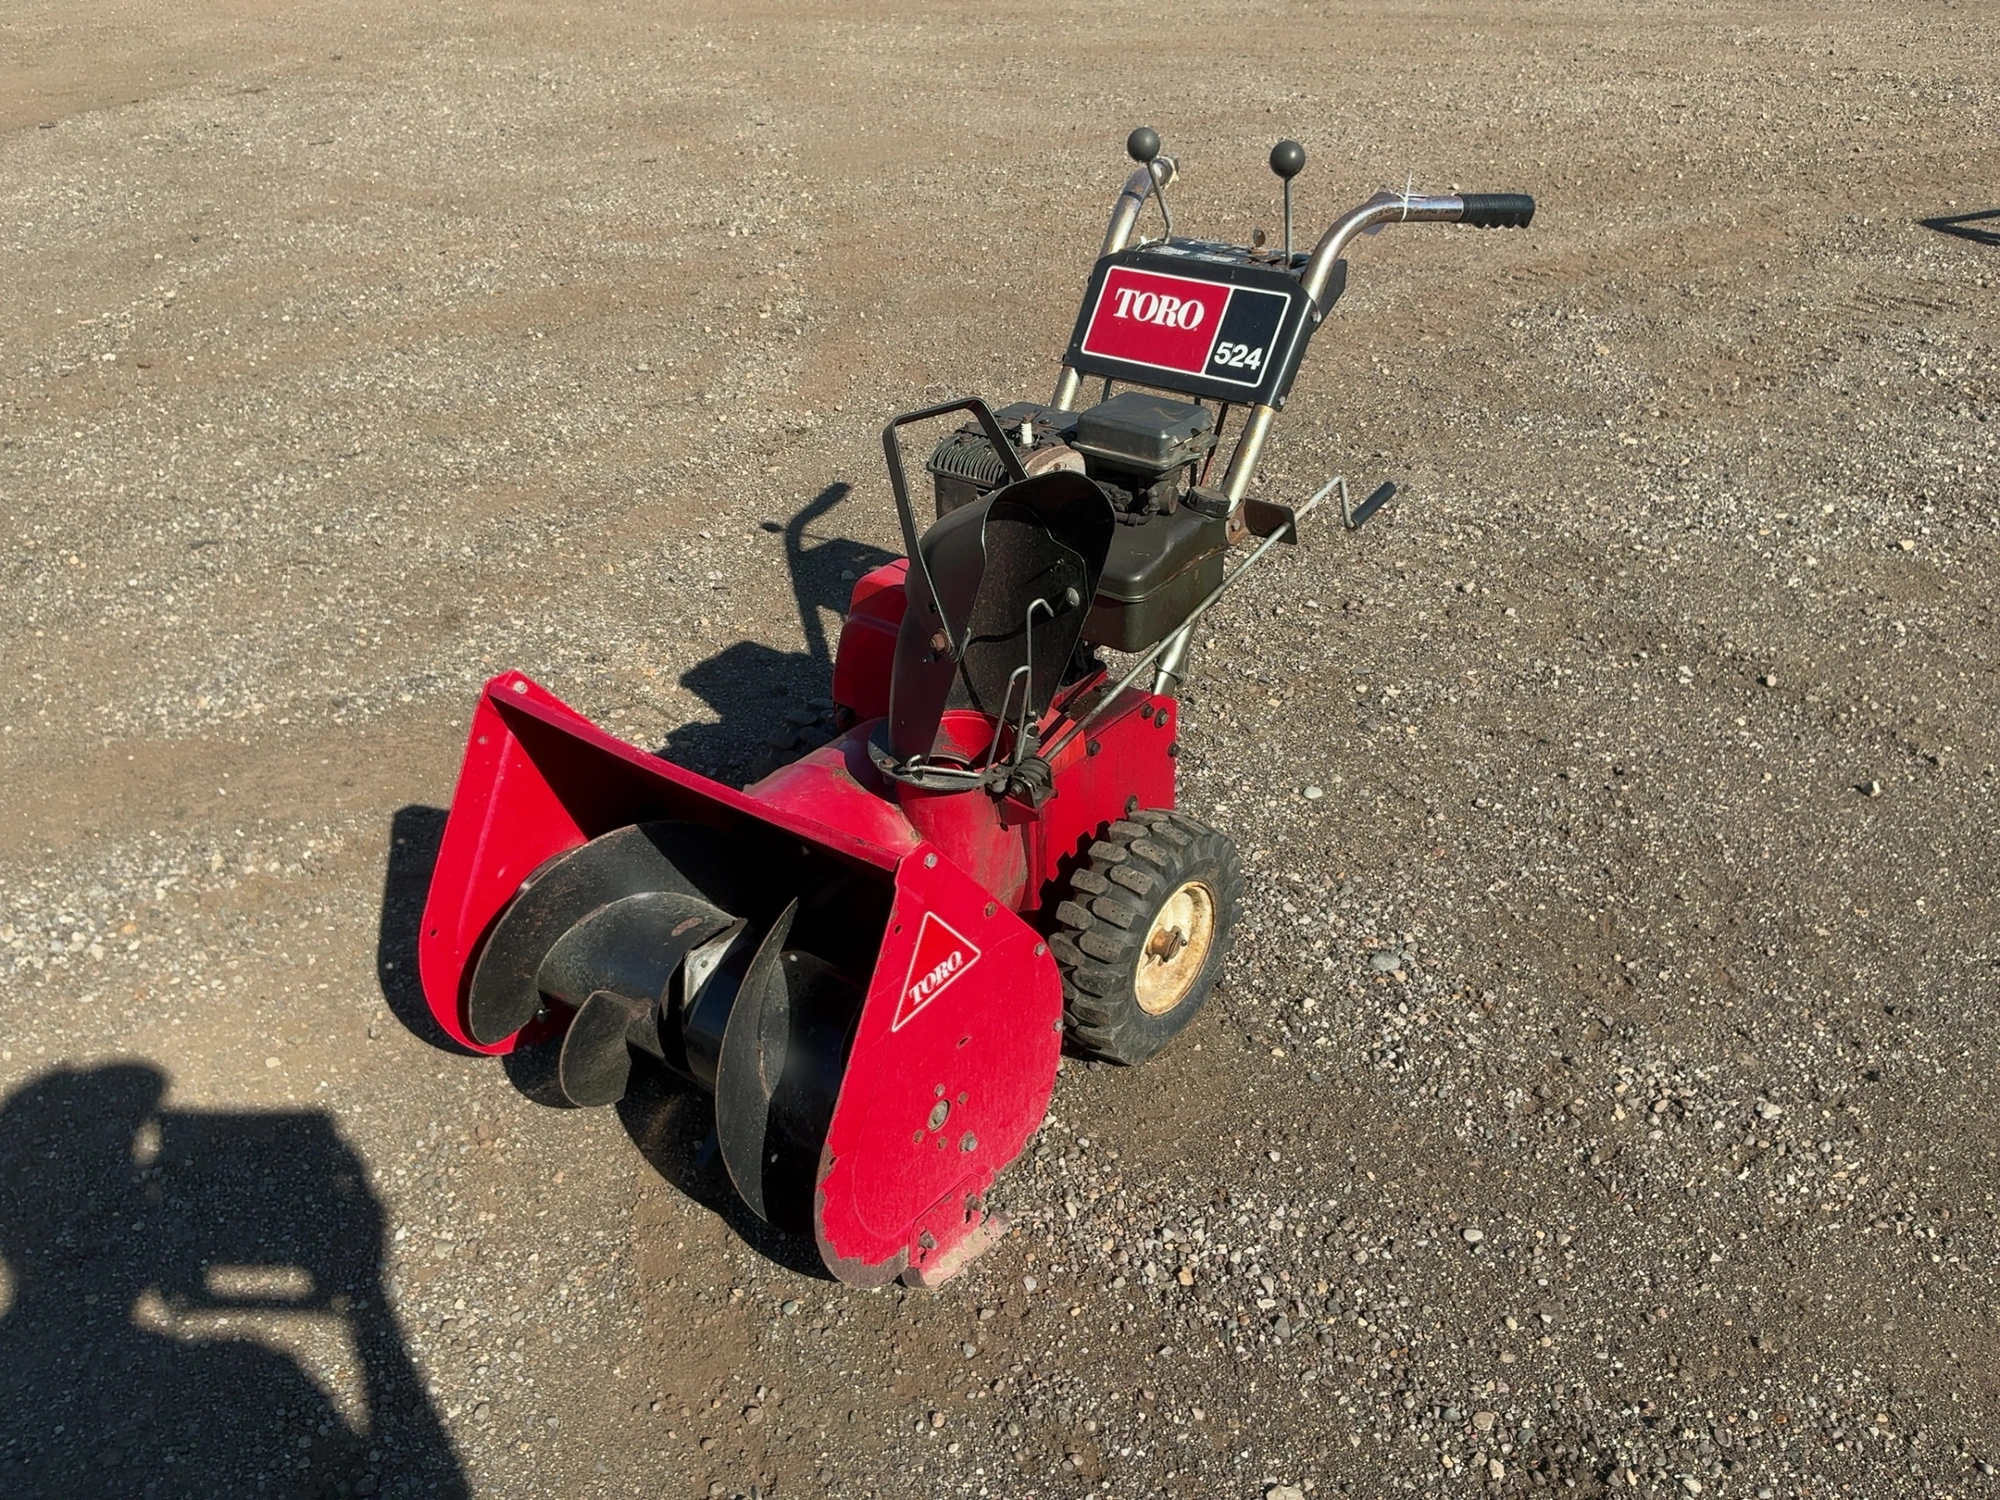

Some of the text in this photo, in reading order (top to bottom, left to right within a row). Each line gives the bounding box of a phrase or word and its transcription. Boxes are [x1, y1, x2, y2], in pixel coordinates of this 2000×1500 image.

[1113, 287, 1205, 330] TORO
[1214, 341, 1264, 371] 524
[908, 950, 963, 1006] TORO
